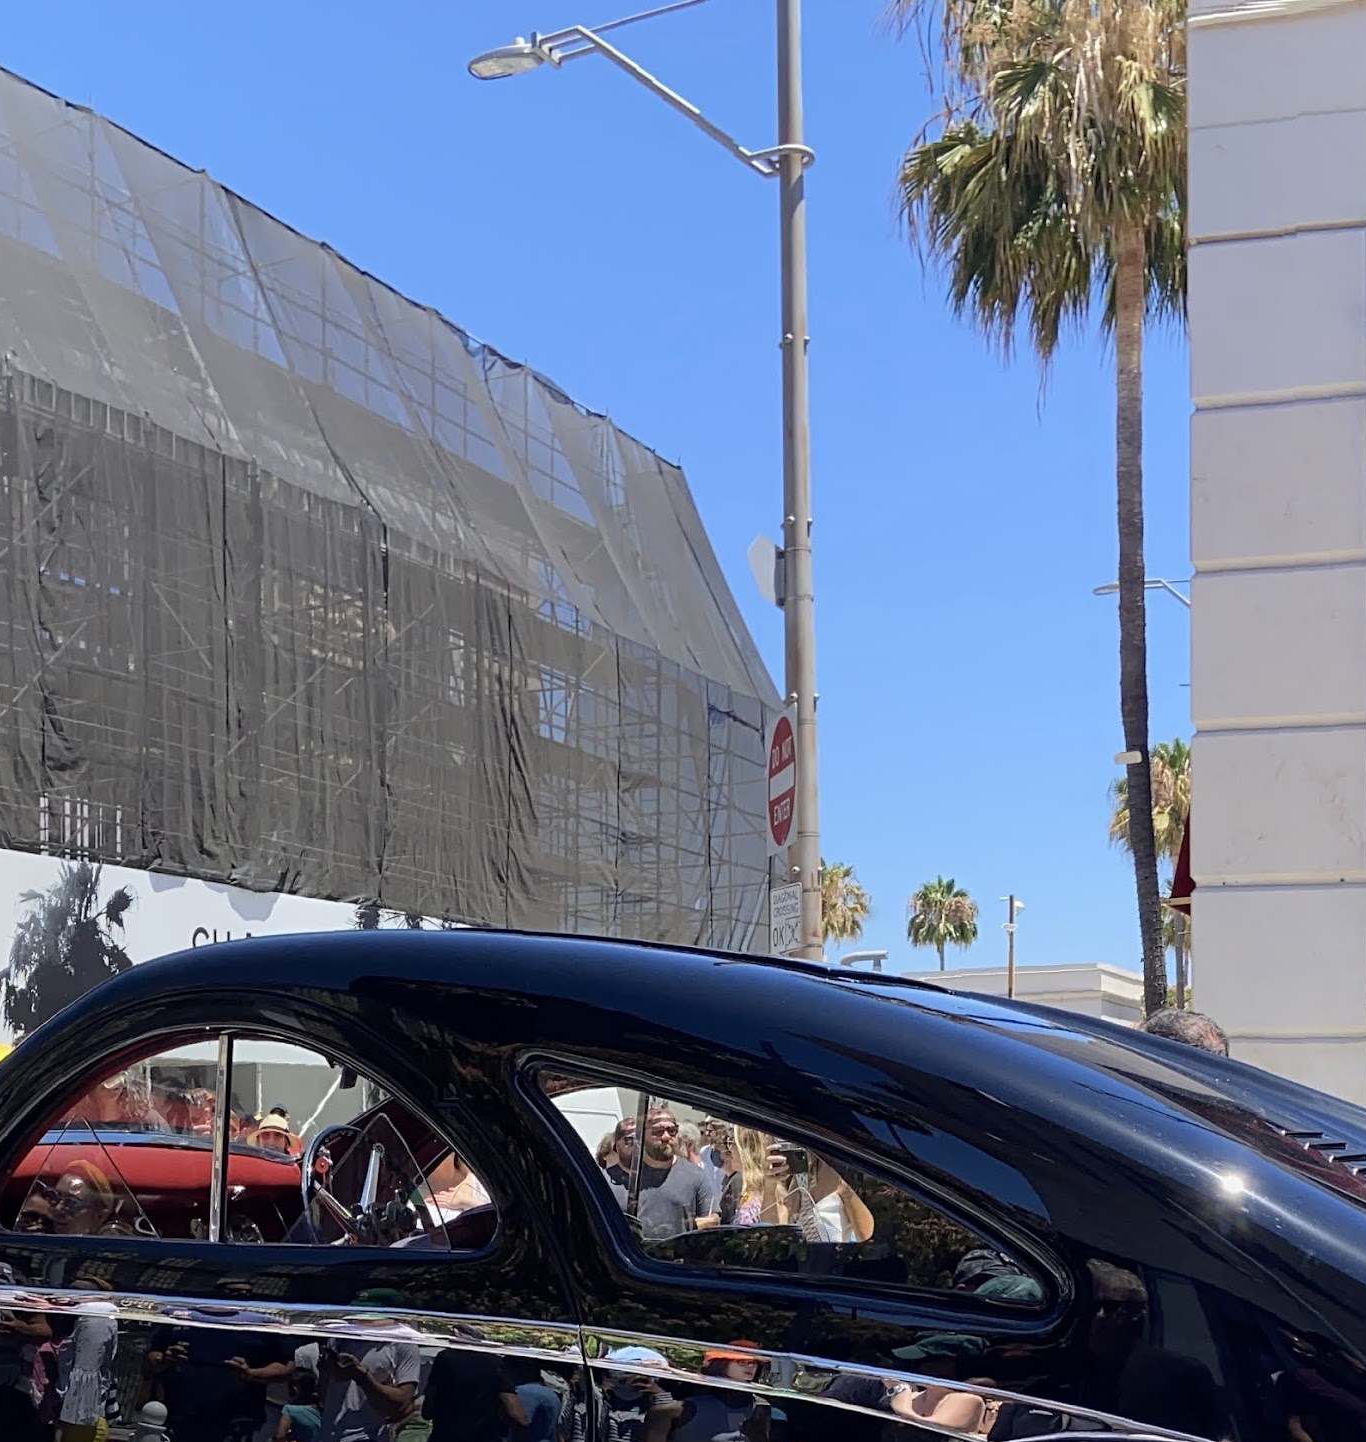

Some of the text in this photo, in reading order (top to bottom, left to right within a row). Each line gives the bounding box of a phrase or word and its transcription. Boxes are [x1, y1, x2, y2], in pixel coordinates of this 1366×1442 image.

[772, 735, 793, 769] DO NOT
[773, 798, 791, 826] ENTER
[773, 926, 784, 948] OK
